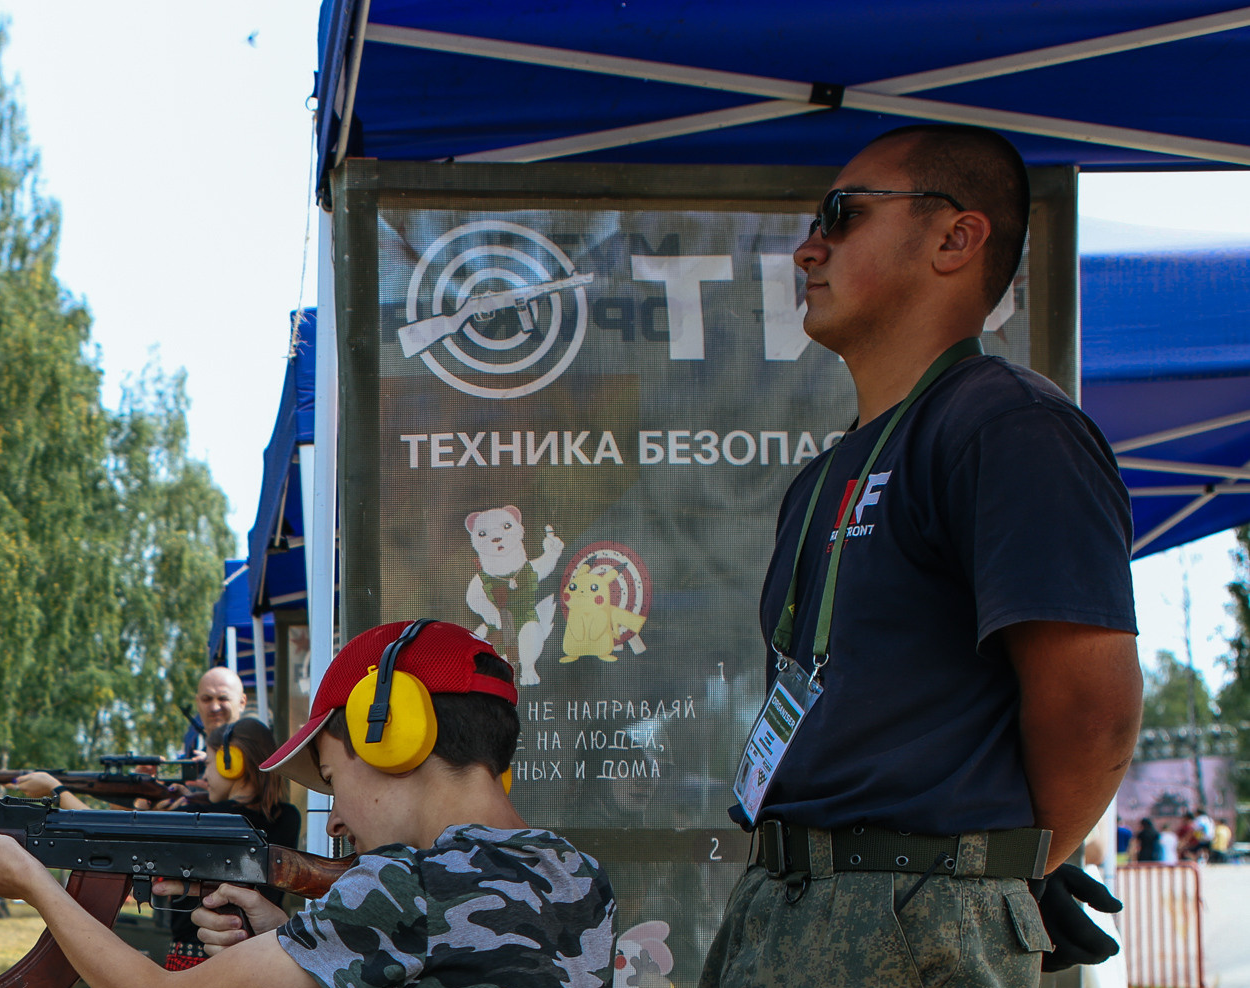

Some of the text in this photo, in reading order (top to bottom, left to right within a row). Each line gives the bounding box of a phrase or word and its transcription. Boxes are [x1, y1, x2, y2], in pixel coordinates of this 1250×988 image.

[400, 430, 624, 469] ТЕХНИКА
[528, 695, 696, 720] НЕ НАПРАВЛЯЙ
[537, 730, 562, 750] НА
[510, 759, 661, 781] НЫХ И ДОМА
[710, 837, 723, 860] 2
